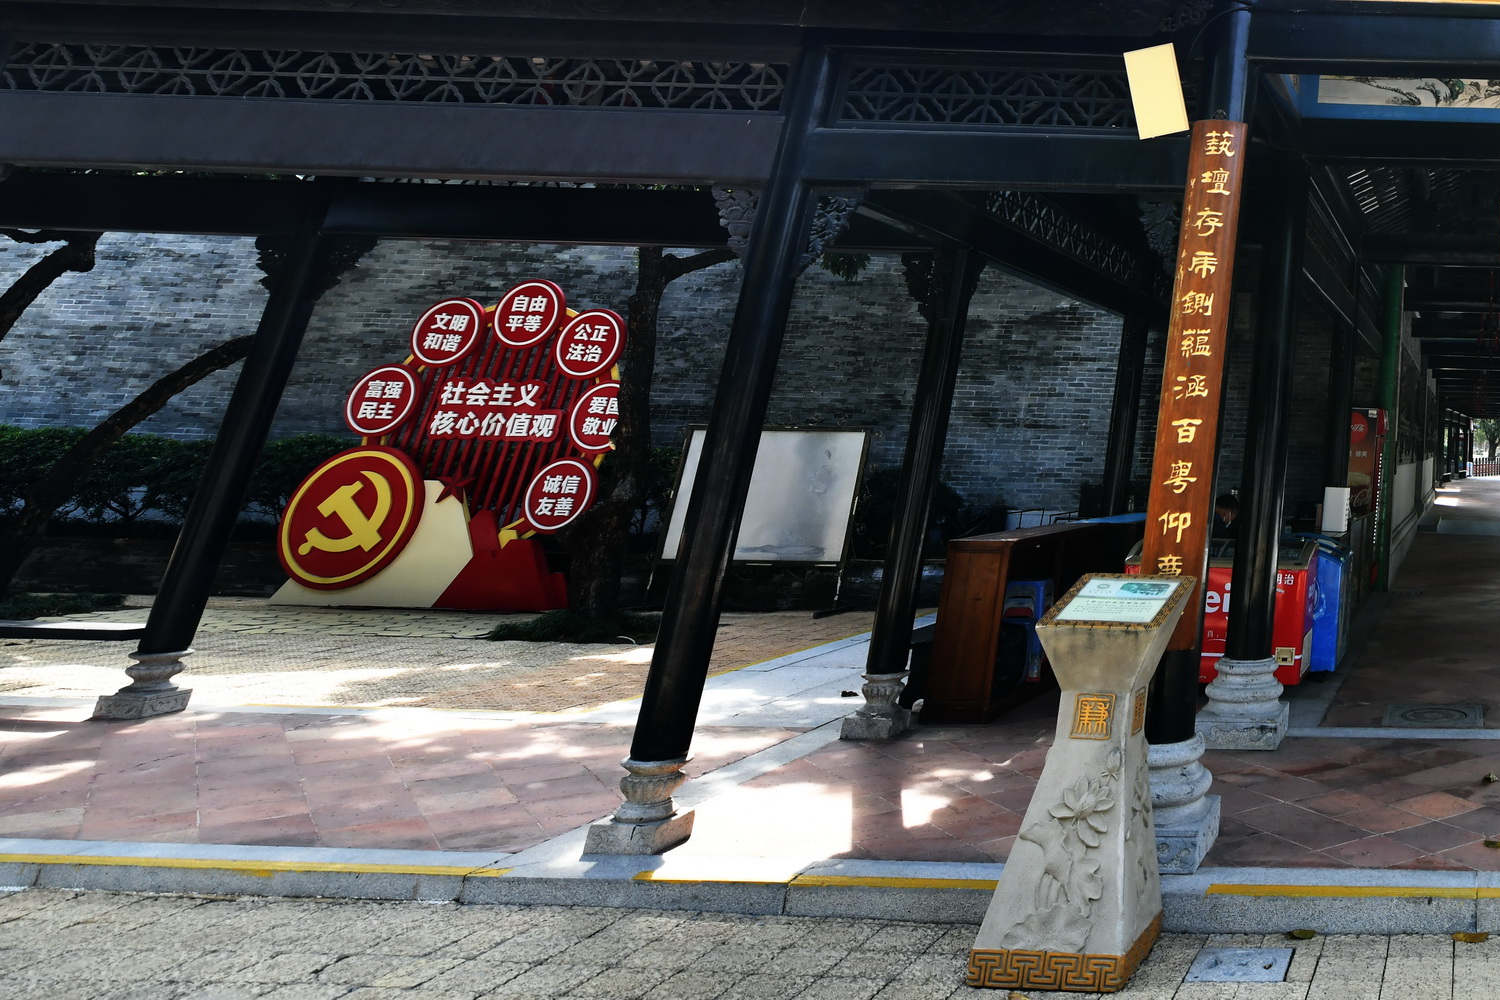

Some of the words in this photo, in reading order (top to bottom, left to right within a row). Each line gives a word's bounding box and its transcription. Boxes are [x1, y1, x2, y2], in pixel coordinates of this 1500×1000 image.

[510, 294, 548, 313] 自由
[431, 312, 470, 331] 文明
[505, 315, 543, 332] 平等
[573, 323, 610, 342] 公正
[423, 333, 462, 352] 和谐
[566, 343, 602, 363] 法治
[364, 380, 404, 399] 富强
[440, 382, 541, 408] 社会主义
[357, 401, 396, 420] 民主
[587, 396, 619, 415] 爱国
[429, 411, 557, 439] 核心价值观
[581, 416, 618, 436] 敬业
[541, 475, 582, 494] 诚信
[535, 496, 574, 517] 友善
